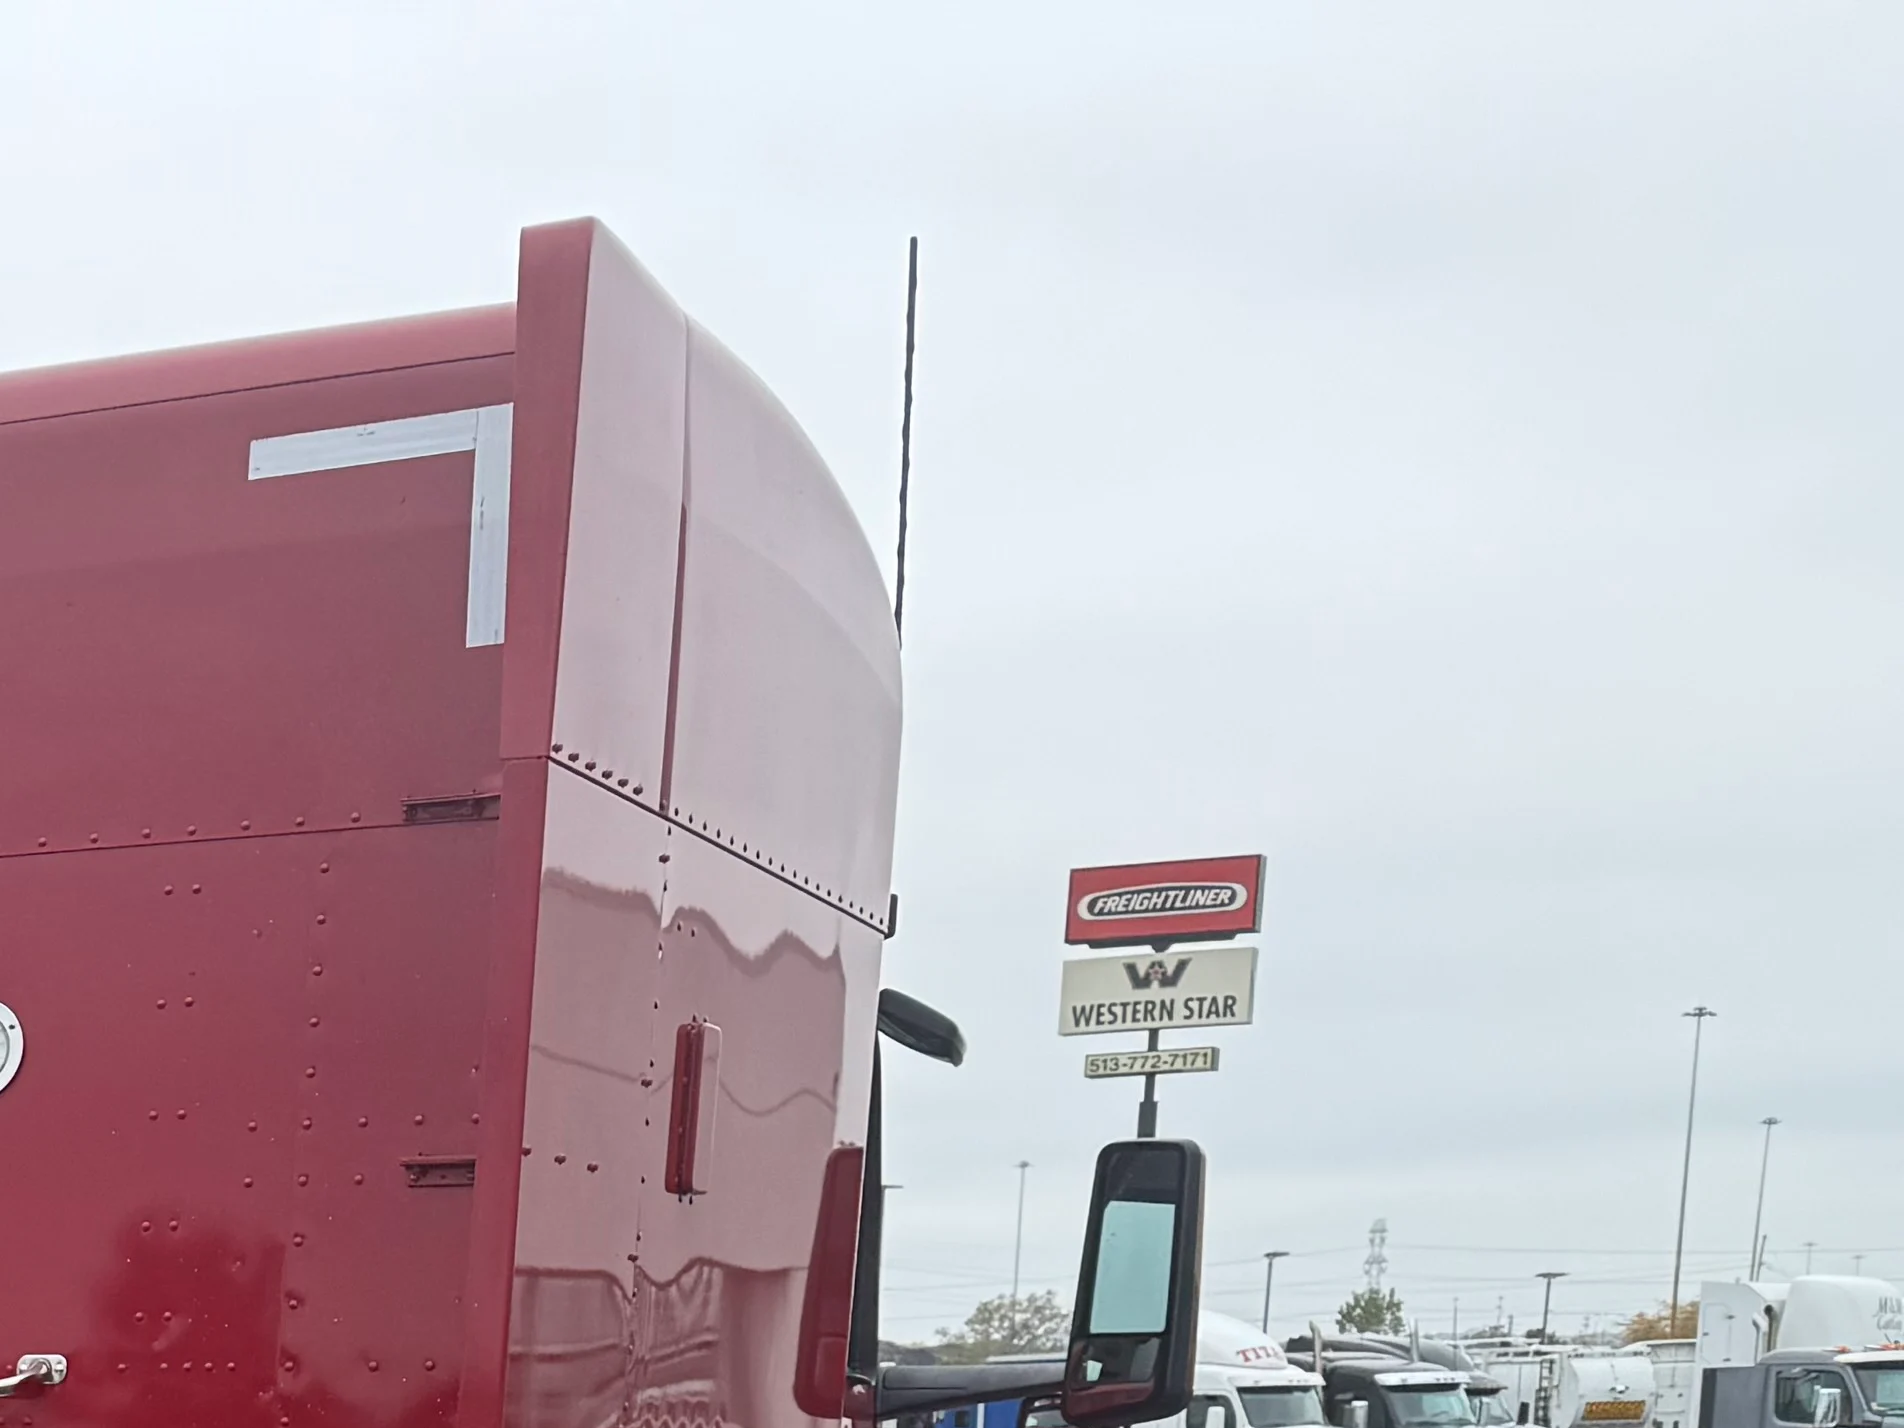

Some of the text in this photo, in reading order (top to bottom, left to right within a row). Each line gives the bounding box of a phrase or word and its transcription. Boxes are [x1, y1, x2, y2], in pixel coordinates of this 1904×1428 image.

[1093, 888, 1233, 915] FREIGHTLINER
[1071, 995, 1237, 1028] WESTERN STAR
[1089, 1051, 1209, 1074] 513-772-7171
